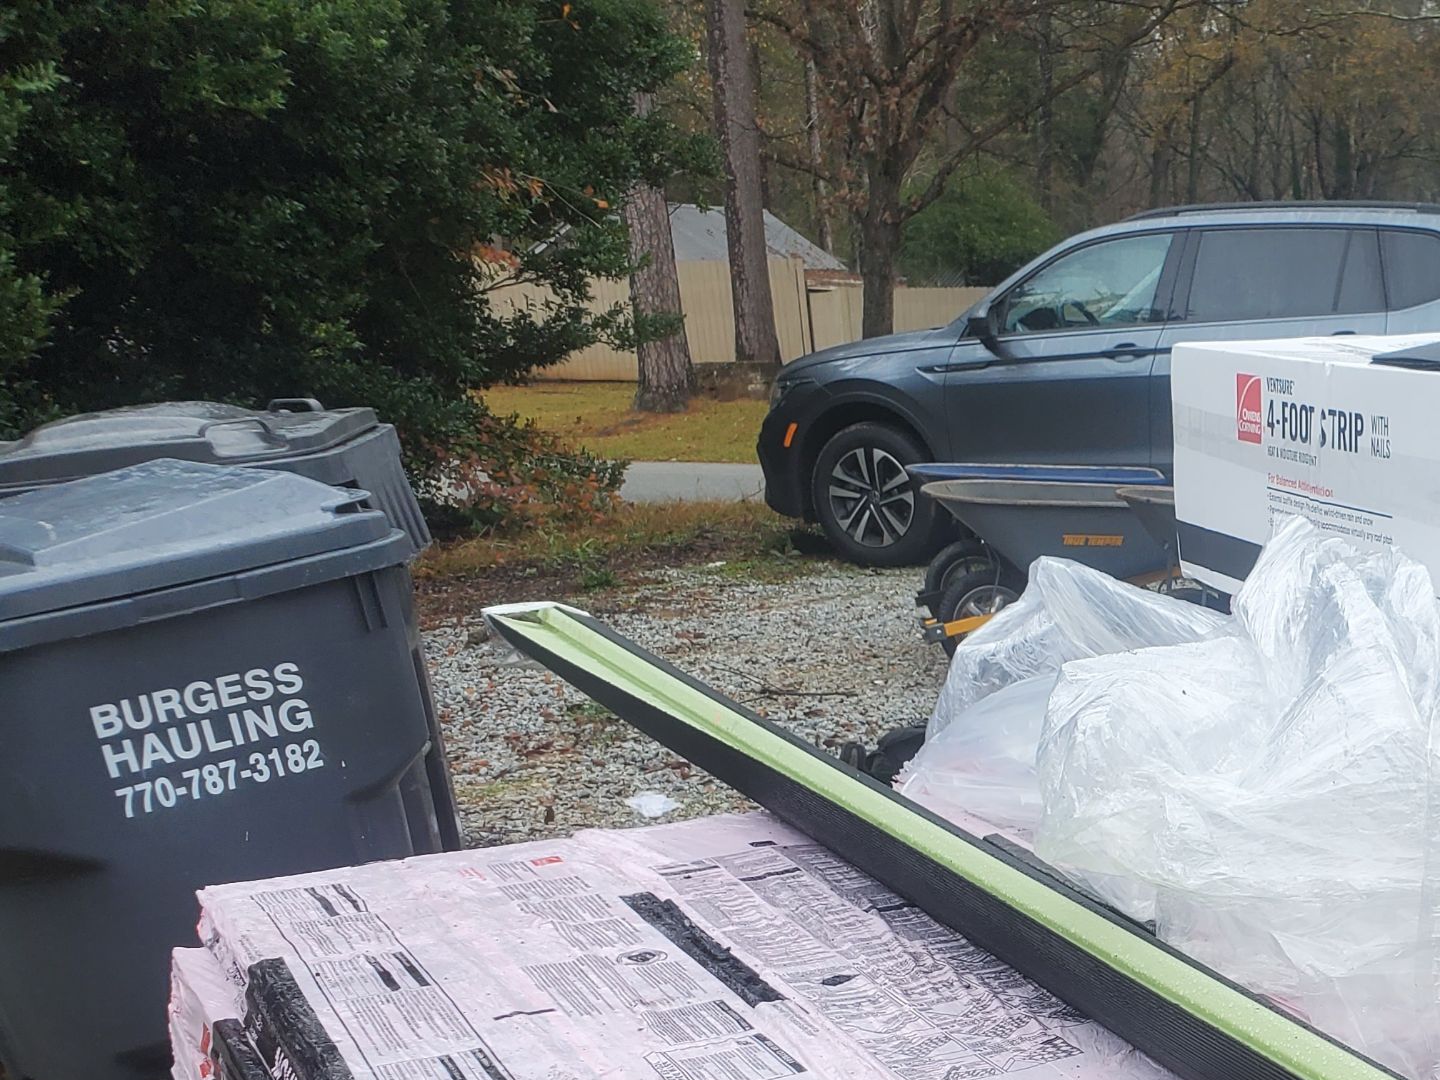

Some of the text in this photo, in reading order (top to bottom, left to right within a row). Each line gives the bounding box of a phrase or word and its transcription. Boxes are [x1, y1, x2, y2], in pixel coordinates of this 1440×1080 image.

[1266, 399, 1364, 453] 4-FOOT STRIP
[1371, 415, 1389, 436] WITH
[1371, 440, 1391, 459] NAILS
[89, 662, 304, 739] BURGESS
[101, 699, 314, 778] HAULING
[115, 739, 324, 818] 770-787-3182
